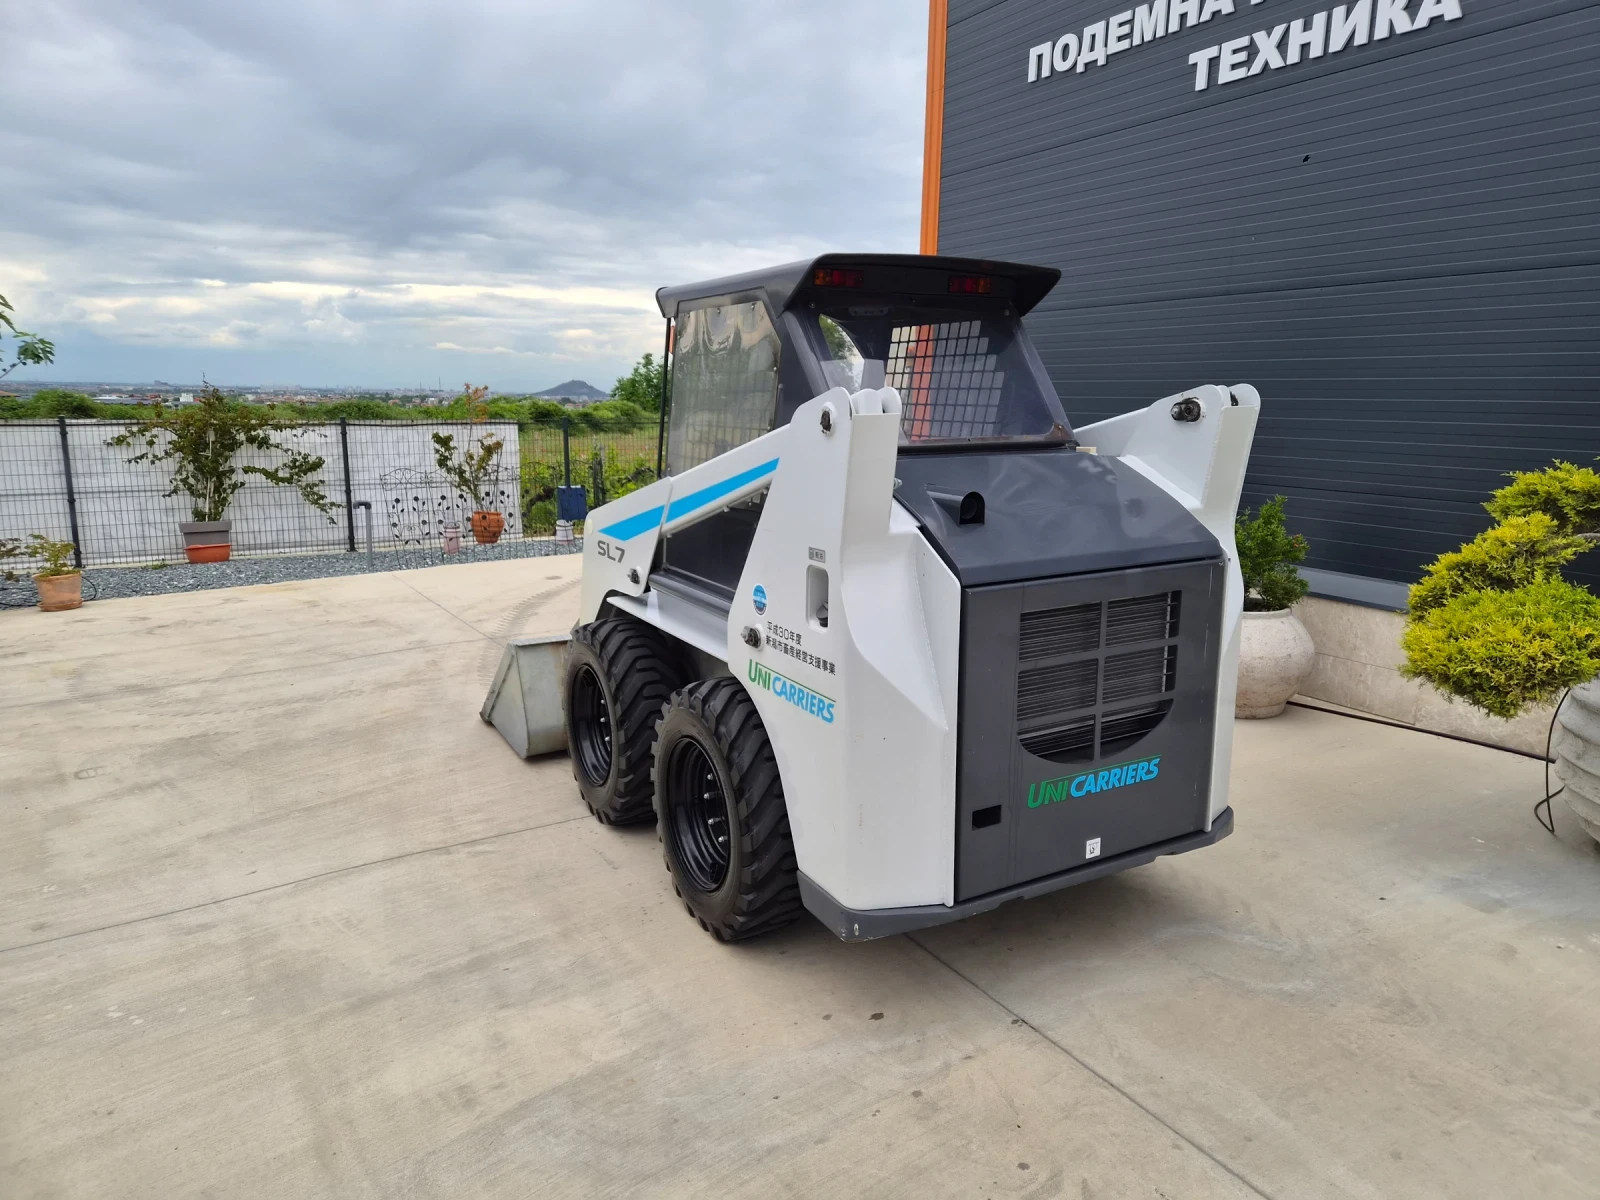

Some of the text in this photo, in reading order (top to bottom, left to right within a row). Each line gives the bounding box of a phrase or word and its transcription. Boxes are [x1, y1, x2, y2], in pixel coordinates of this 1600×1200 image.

[1188, 0, 1463, 91] ТЕХНИКА
[597, 540, 625, 563] SL7
[766, 620, 802, 646] 平成30年度
